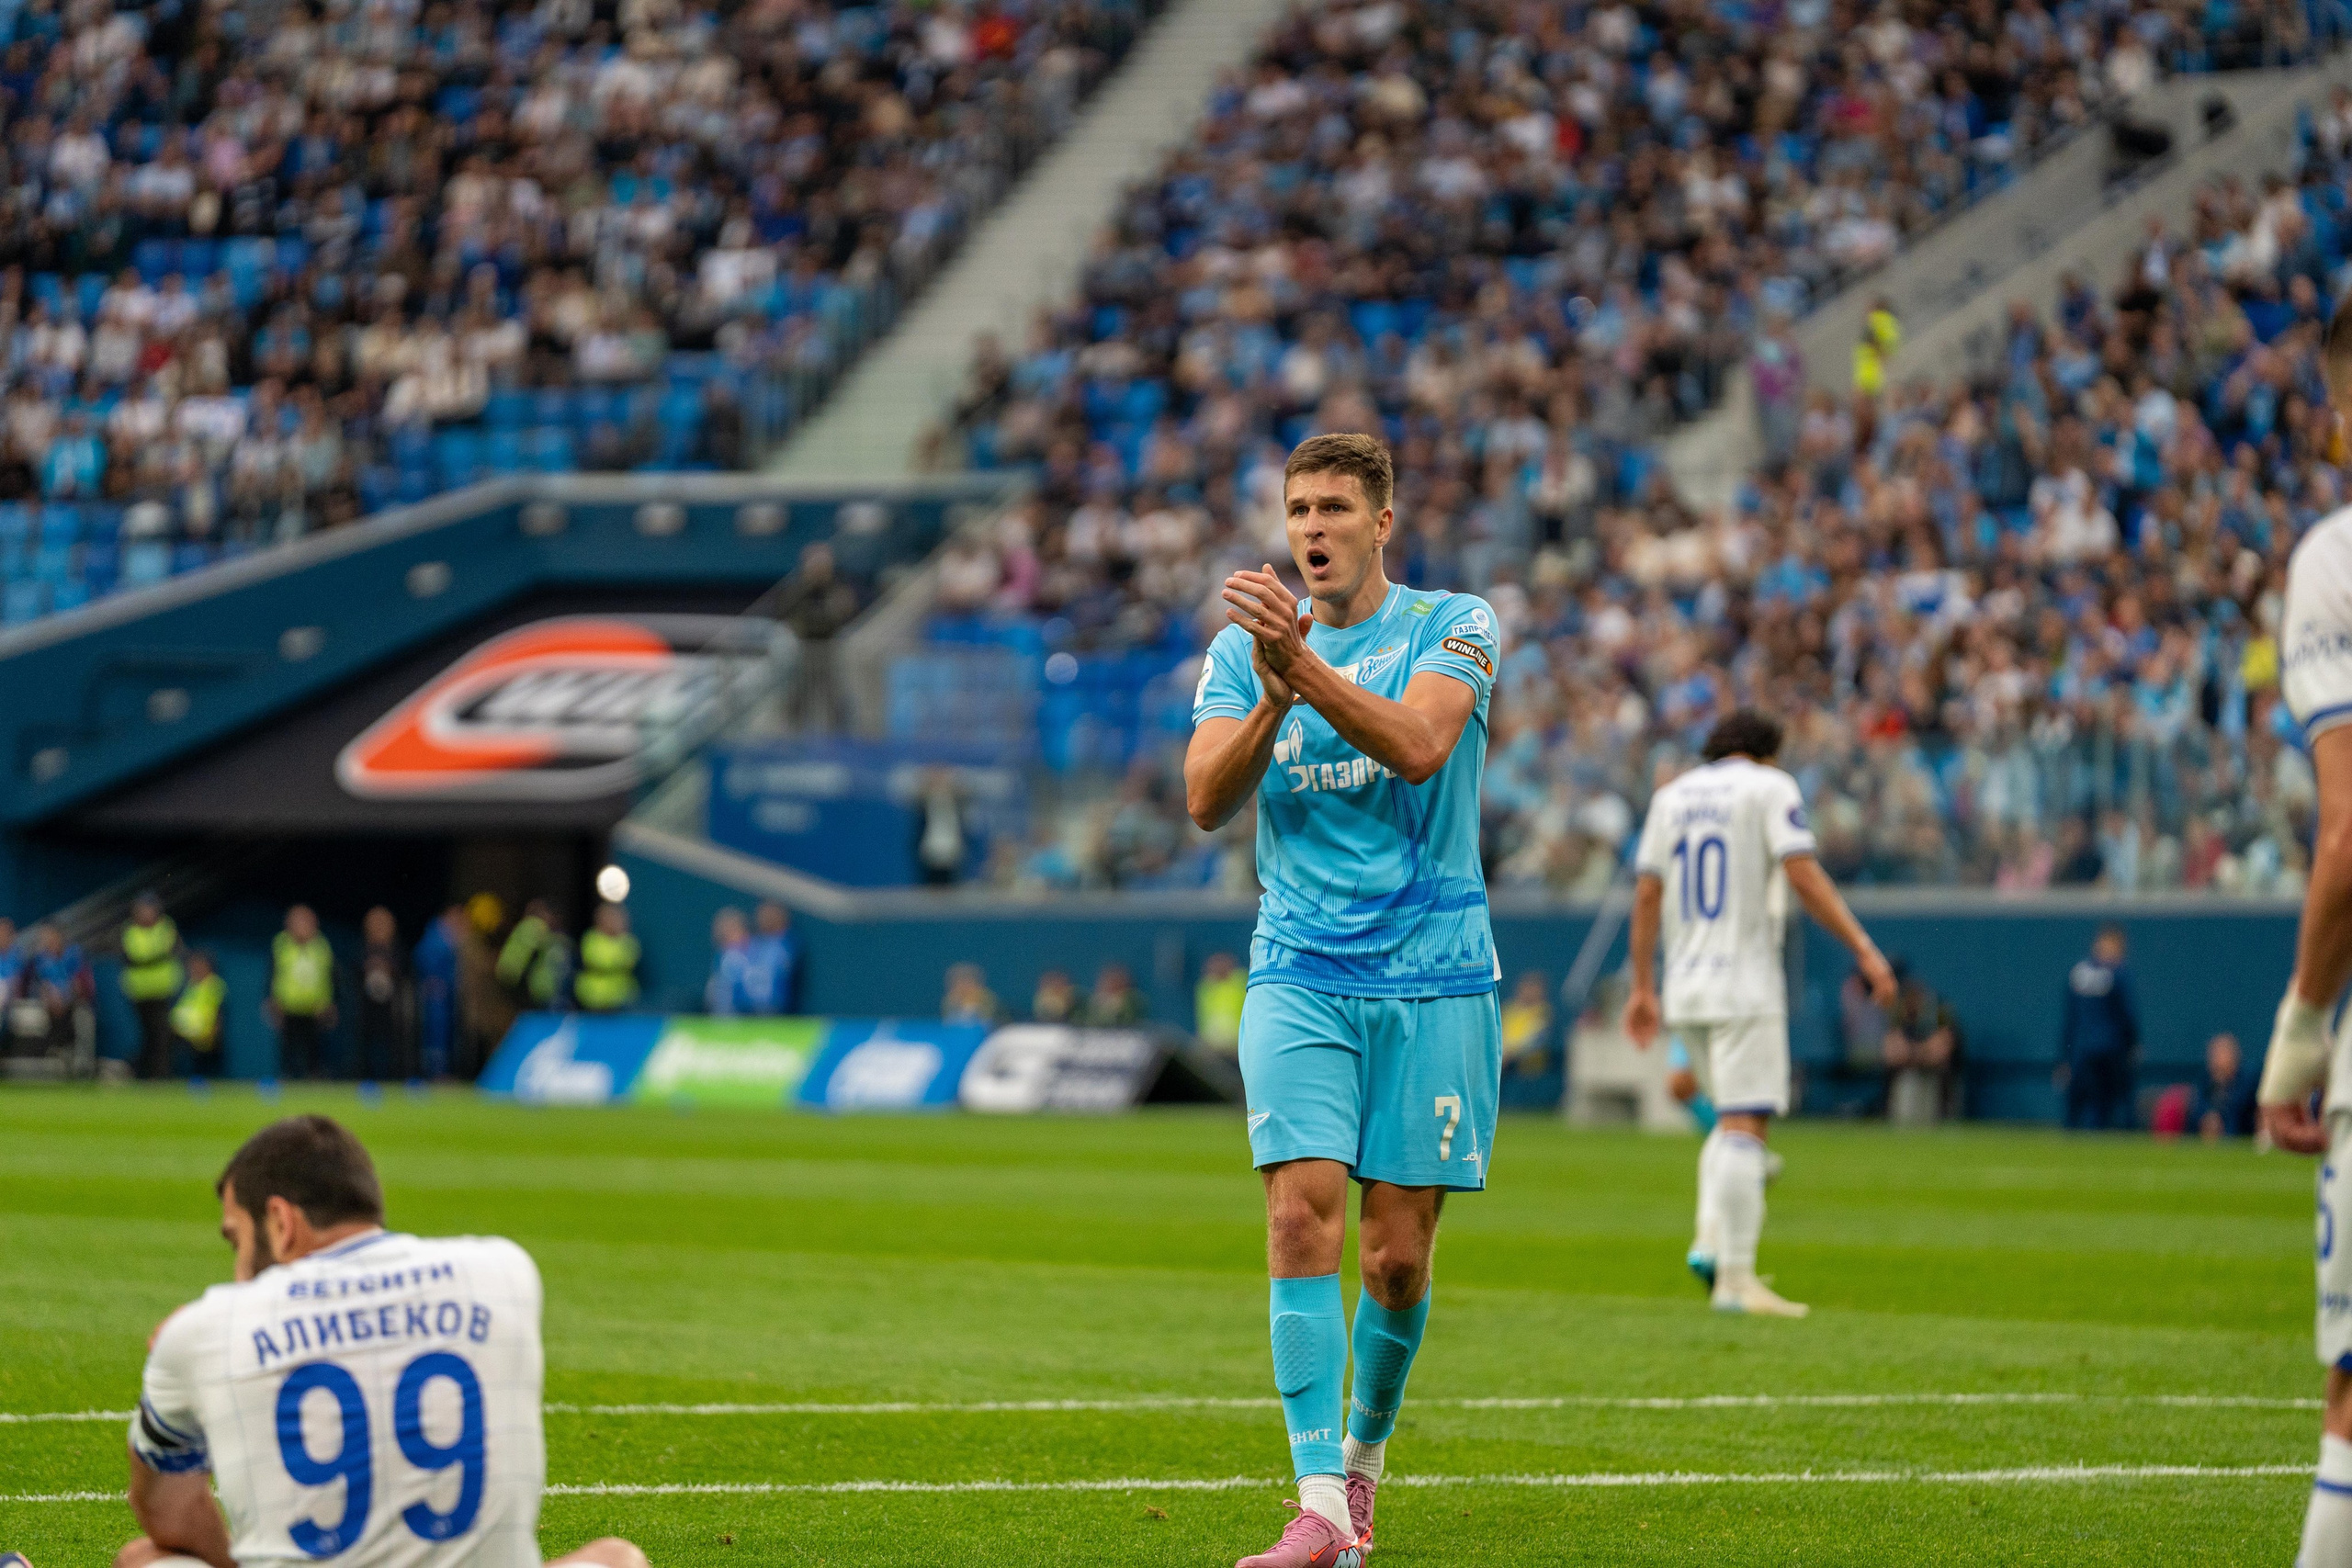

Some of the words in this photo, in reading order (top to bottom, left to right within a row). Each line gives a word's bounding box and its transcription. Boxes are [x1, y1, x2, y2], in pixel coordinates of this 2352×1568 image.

[1447, 640, 1487, 667] WINLINE
[1673, 834, 1727, 922] 10
[1435, 1096, 1460, 1162] 7
[252, 1301, 492, 1367] АЛИБЕКОВ
[276, 1352, 487, 1559] 99
[1289, 1428, 1332, 1445] ЕНИТ
